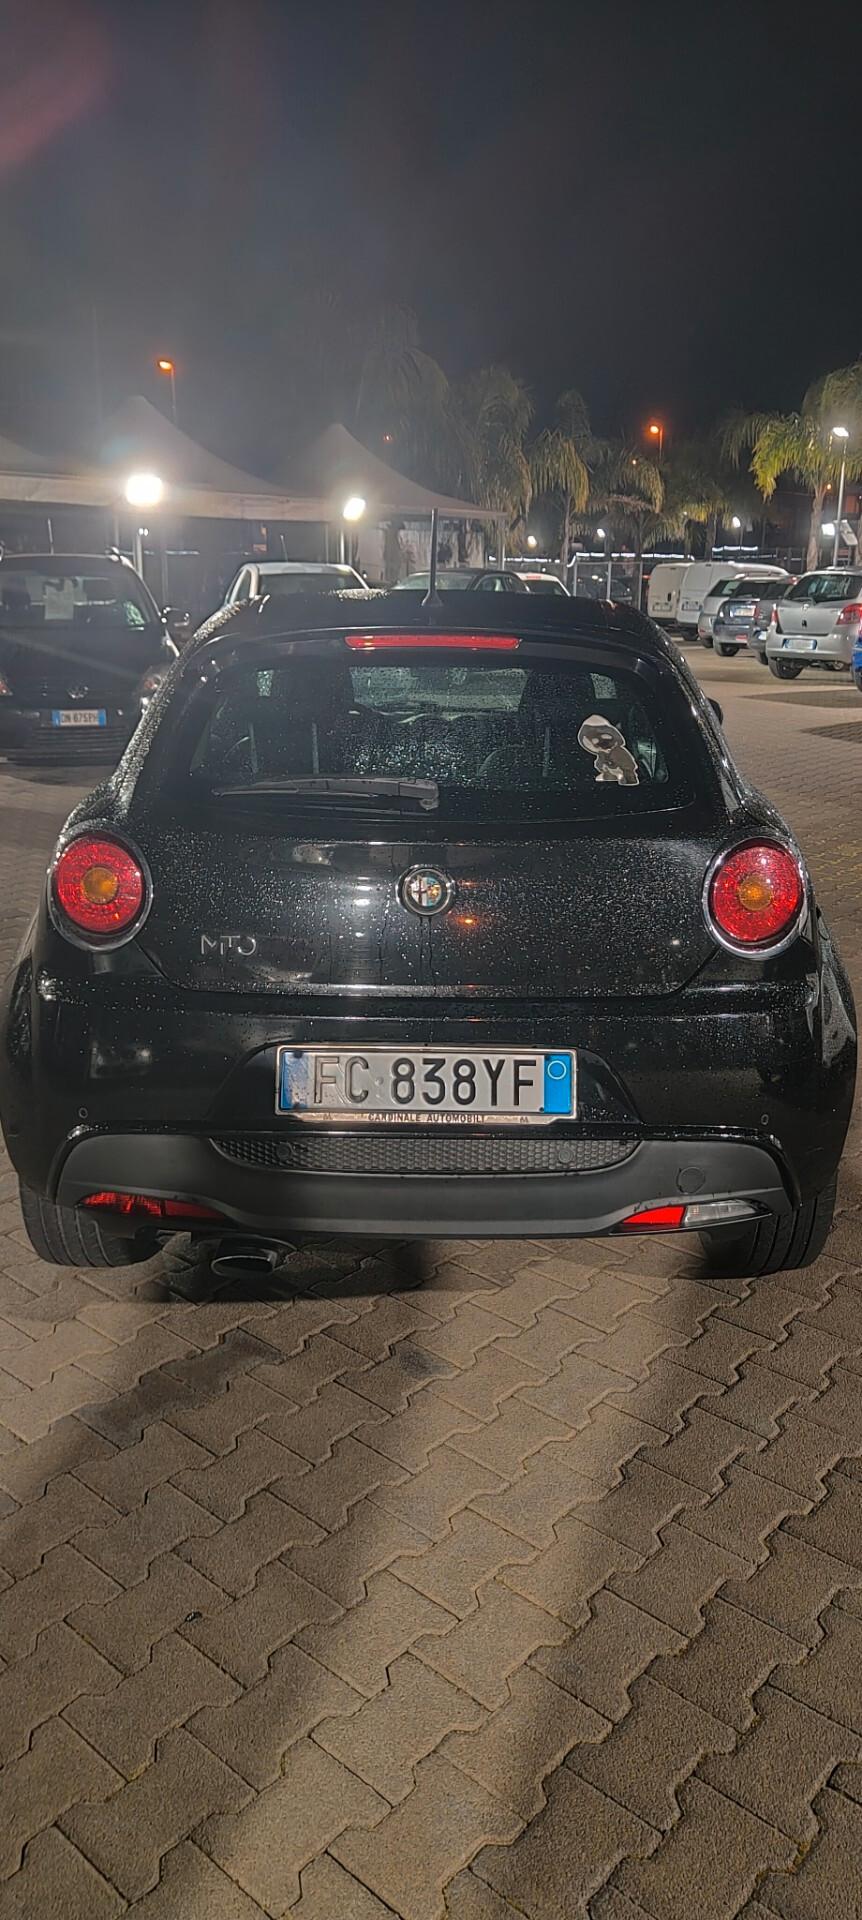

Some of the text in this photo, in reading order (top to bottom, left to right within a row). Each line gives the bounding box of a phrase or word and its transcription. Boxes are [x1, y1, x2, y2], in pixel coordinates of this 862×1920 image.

[313, 1054, 537, 1106] FC 838YF
[368, 1112, 486, 1123] CARDINALE AUTOMOBILI
